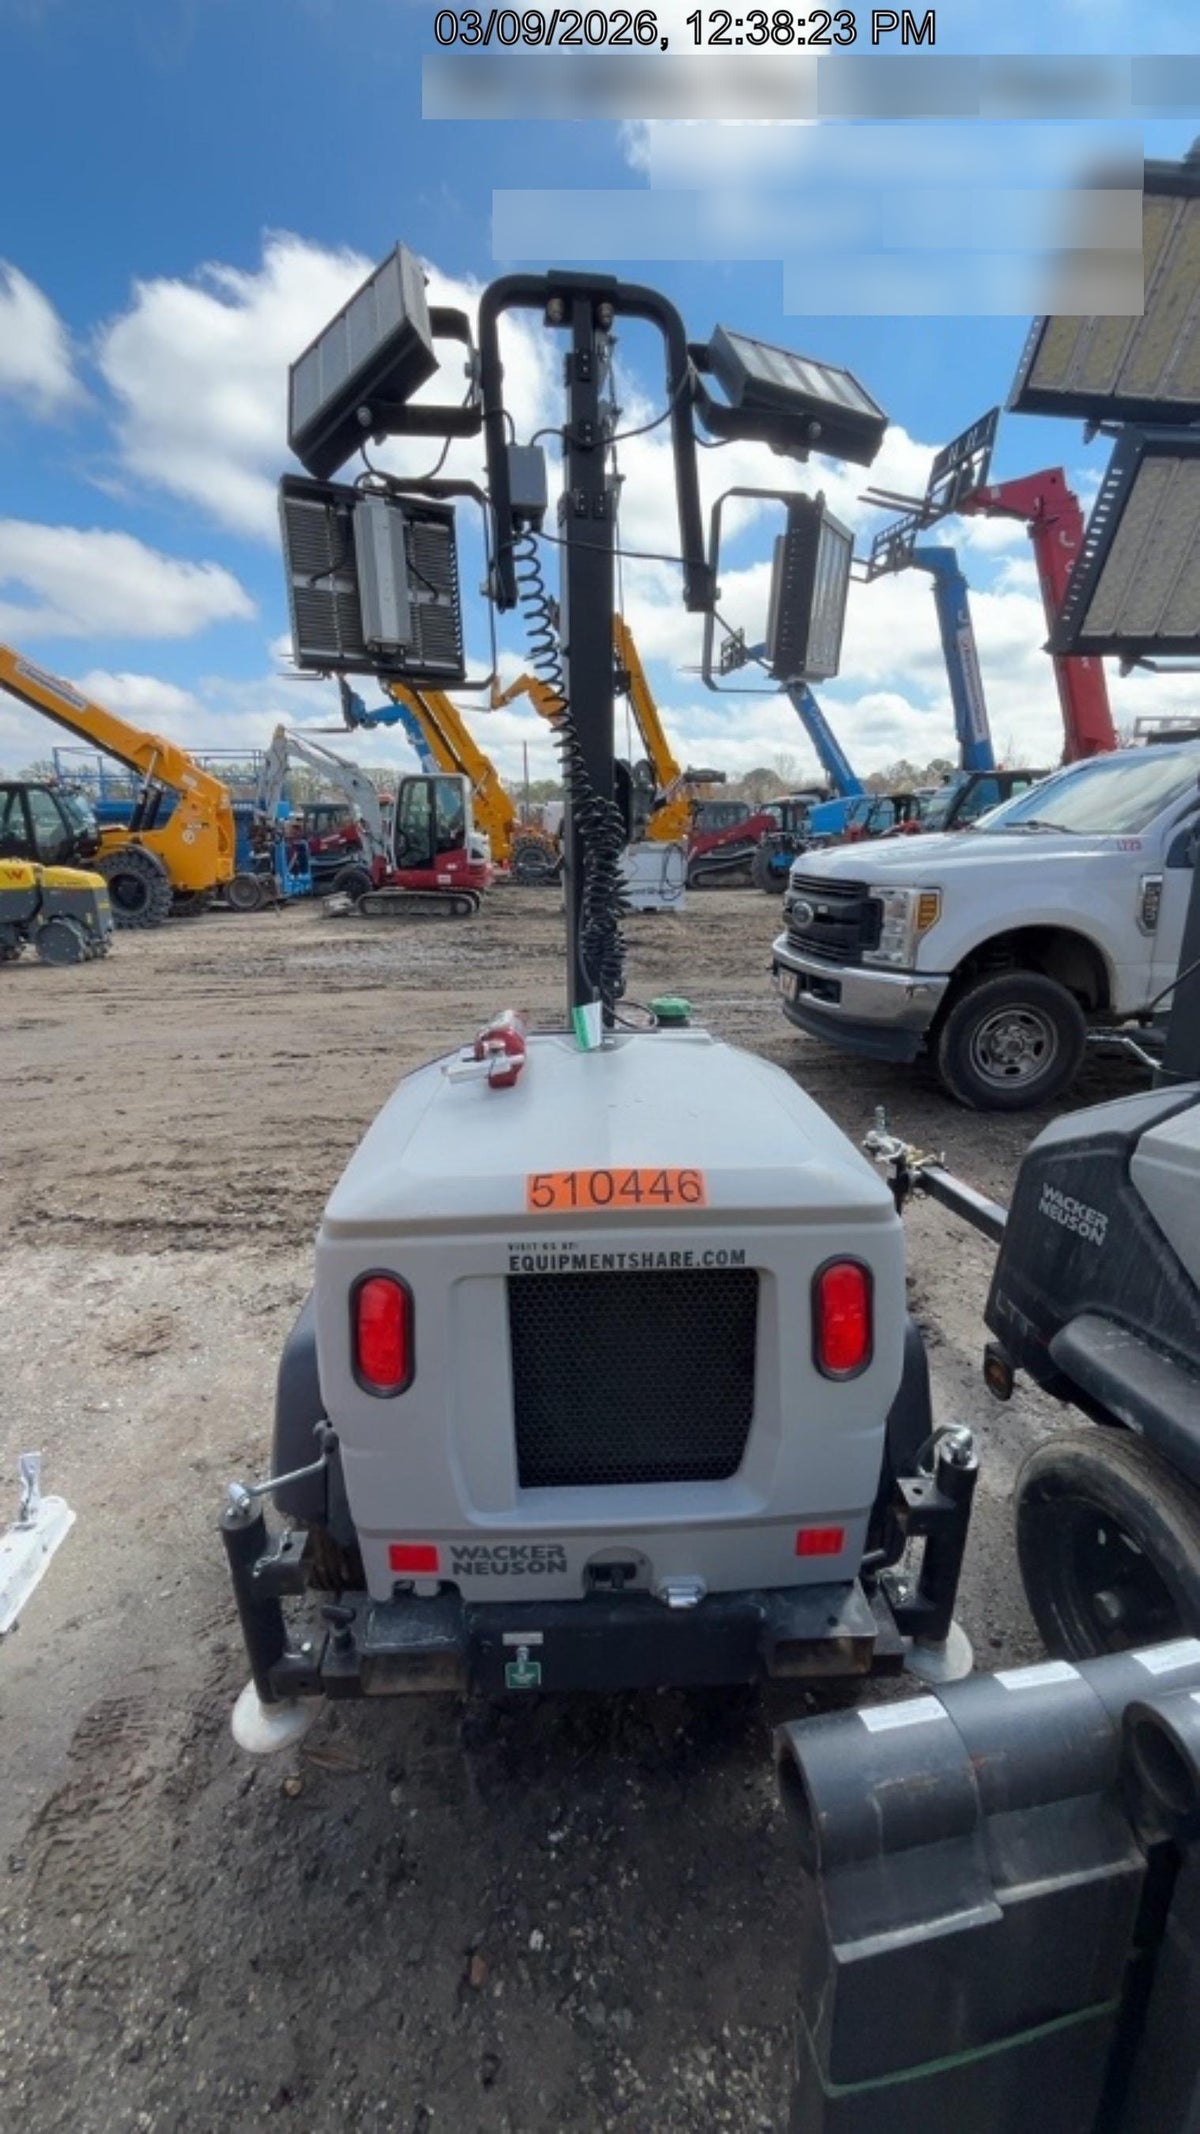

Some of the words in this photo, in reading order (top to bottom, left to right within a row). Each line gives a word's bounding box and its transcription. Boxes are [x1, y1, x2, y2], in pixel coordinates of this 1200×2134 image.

[531, 1169, 703, 1208] 510446
[1042, 1182, 1109, 1228] WACKER
[1038, 1197, 1107, 1246] NEUSON
[509, 1249, 746, 1271] EQUIPMENTSHARE.COM
[449, 1545, 566, 1560] WACKER
[452, 1560, 567, 1575] NEUSON
